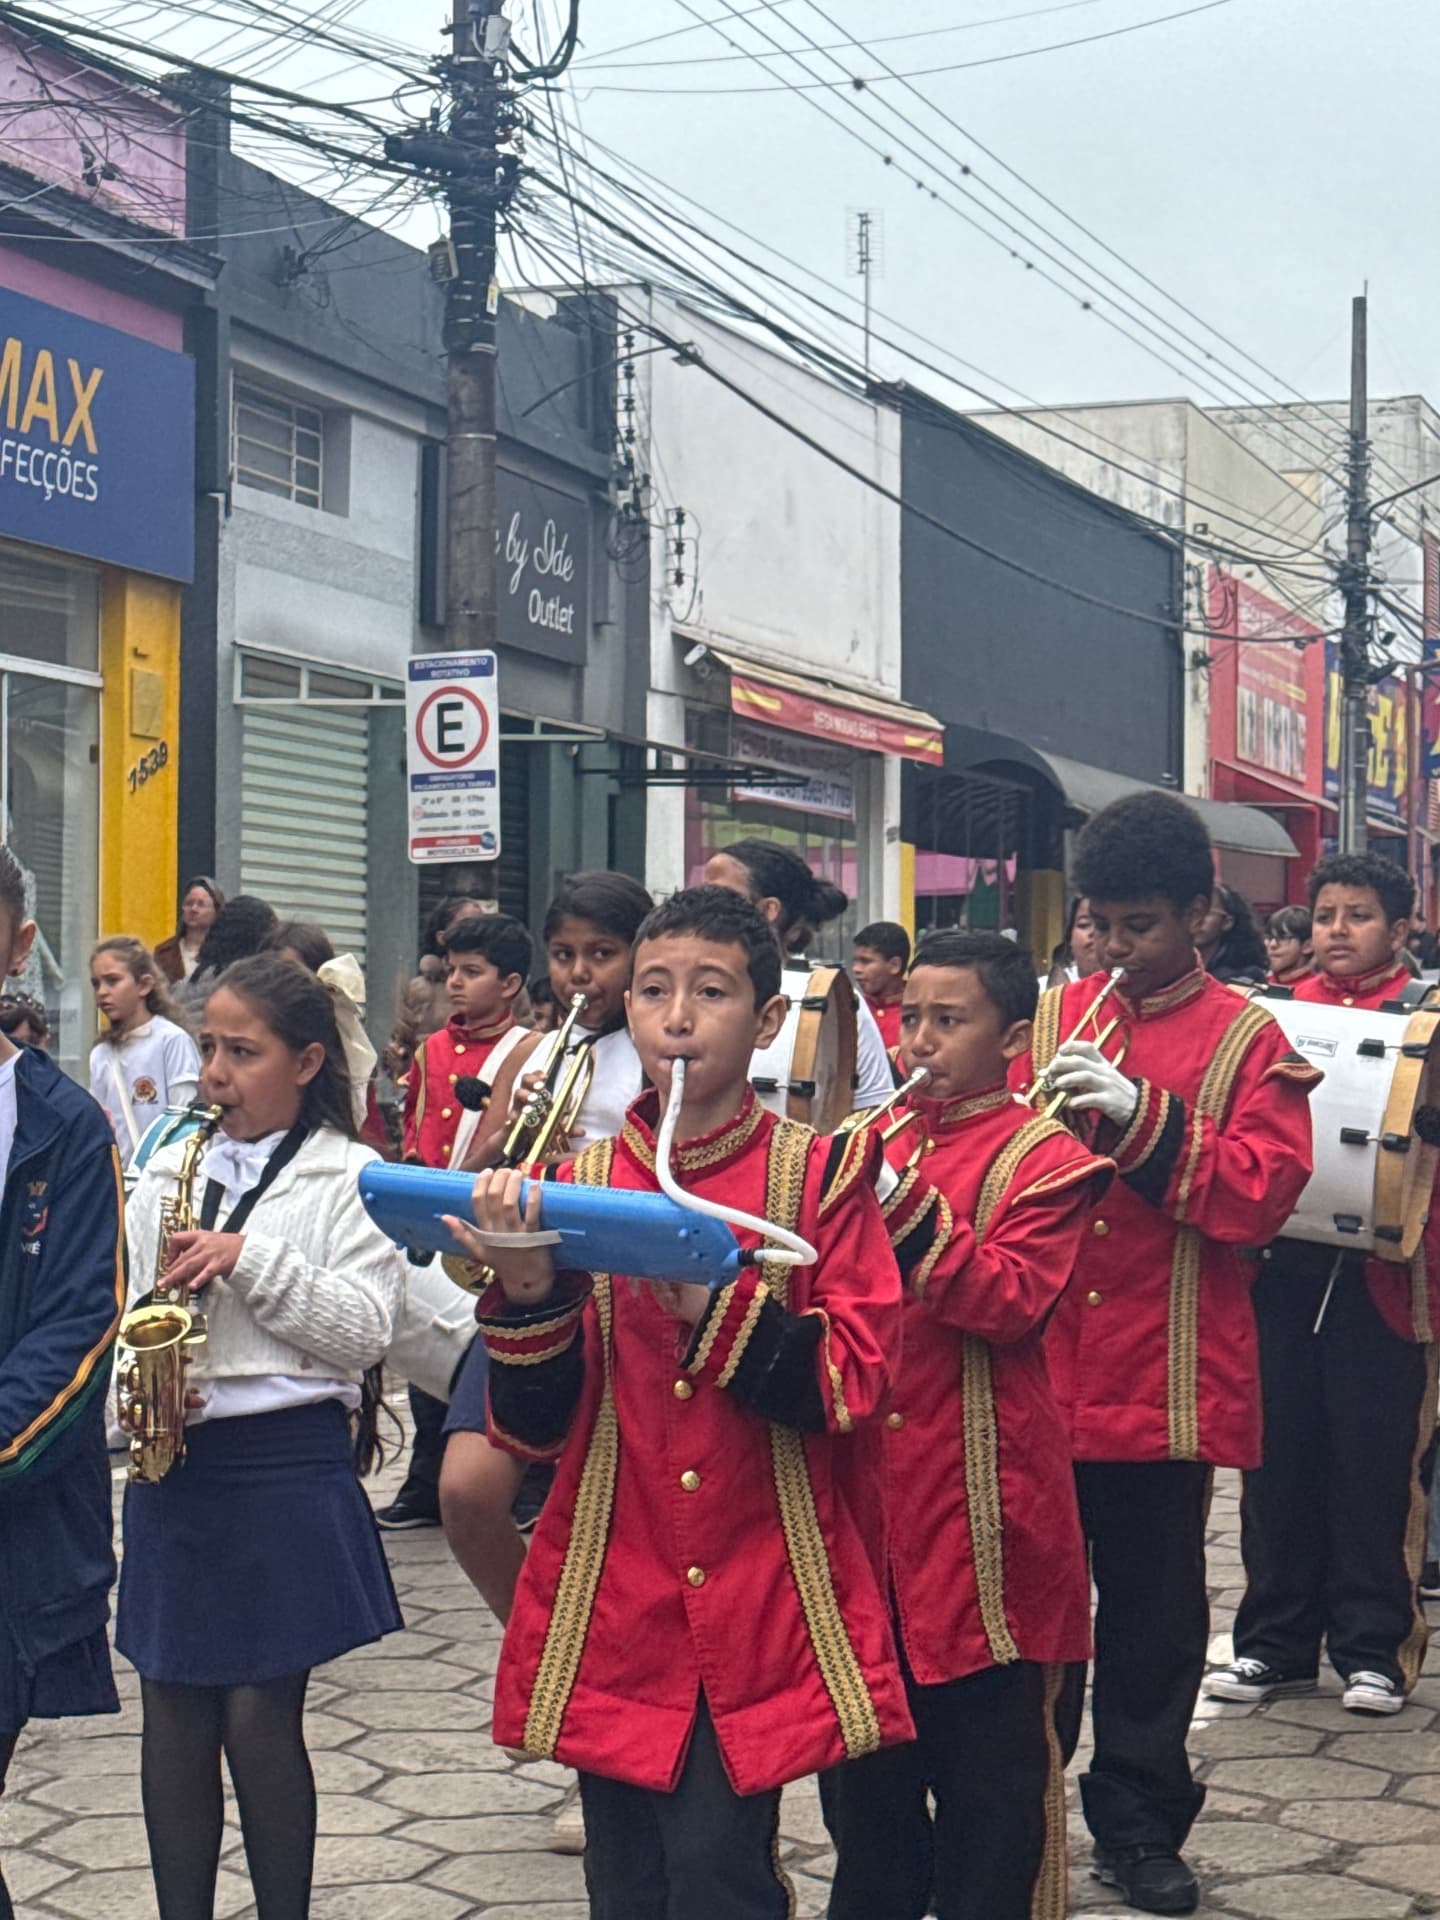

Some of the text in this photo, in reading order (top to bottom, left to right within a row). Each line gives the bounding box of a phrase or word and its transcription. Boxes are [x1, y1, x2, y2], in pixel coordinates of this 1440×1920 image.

[0, 438, 99, 501] FECÇÕES
[528, 588, 575, 634] Outlet
[413, 657, 488, 670] ESTACIONAMENTO
[430, 668, 471, 678] ROTATIVO
[436, 701, 465, 754] E
